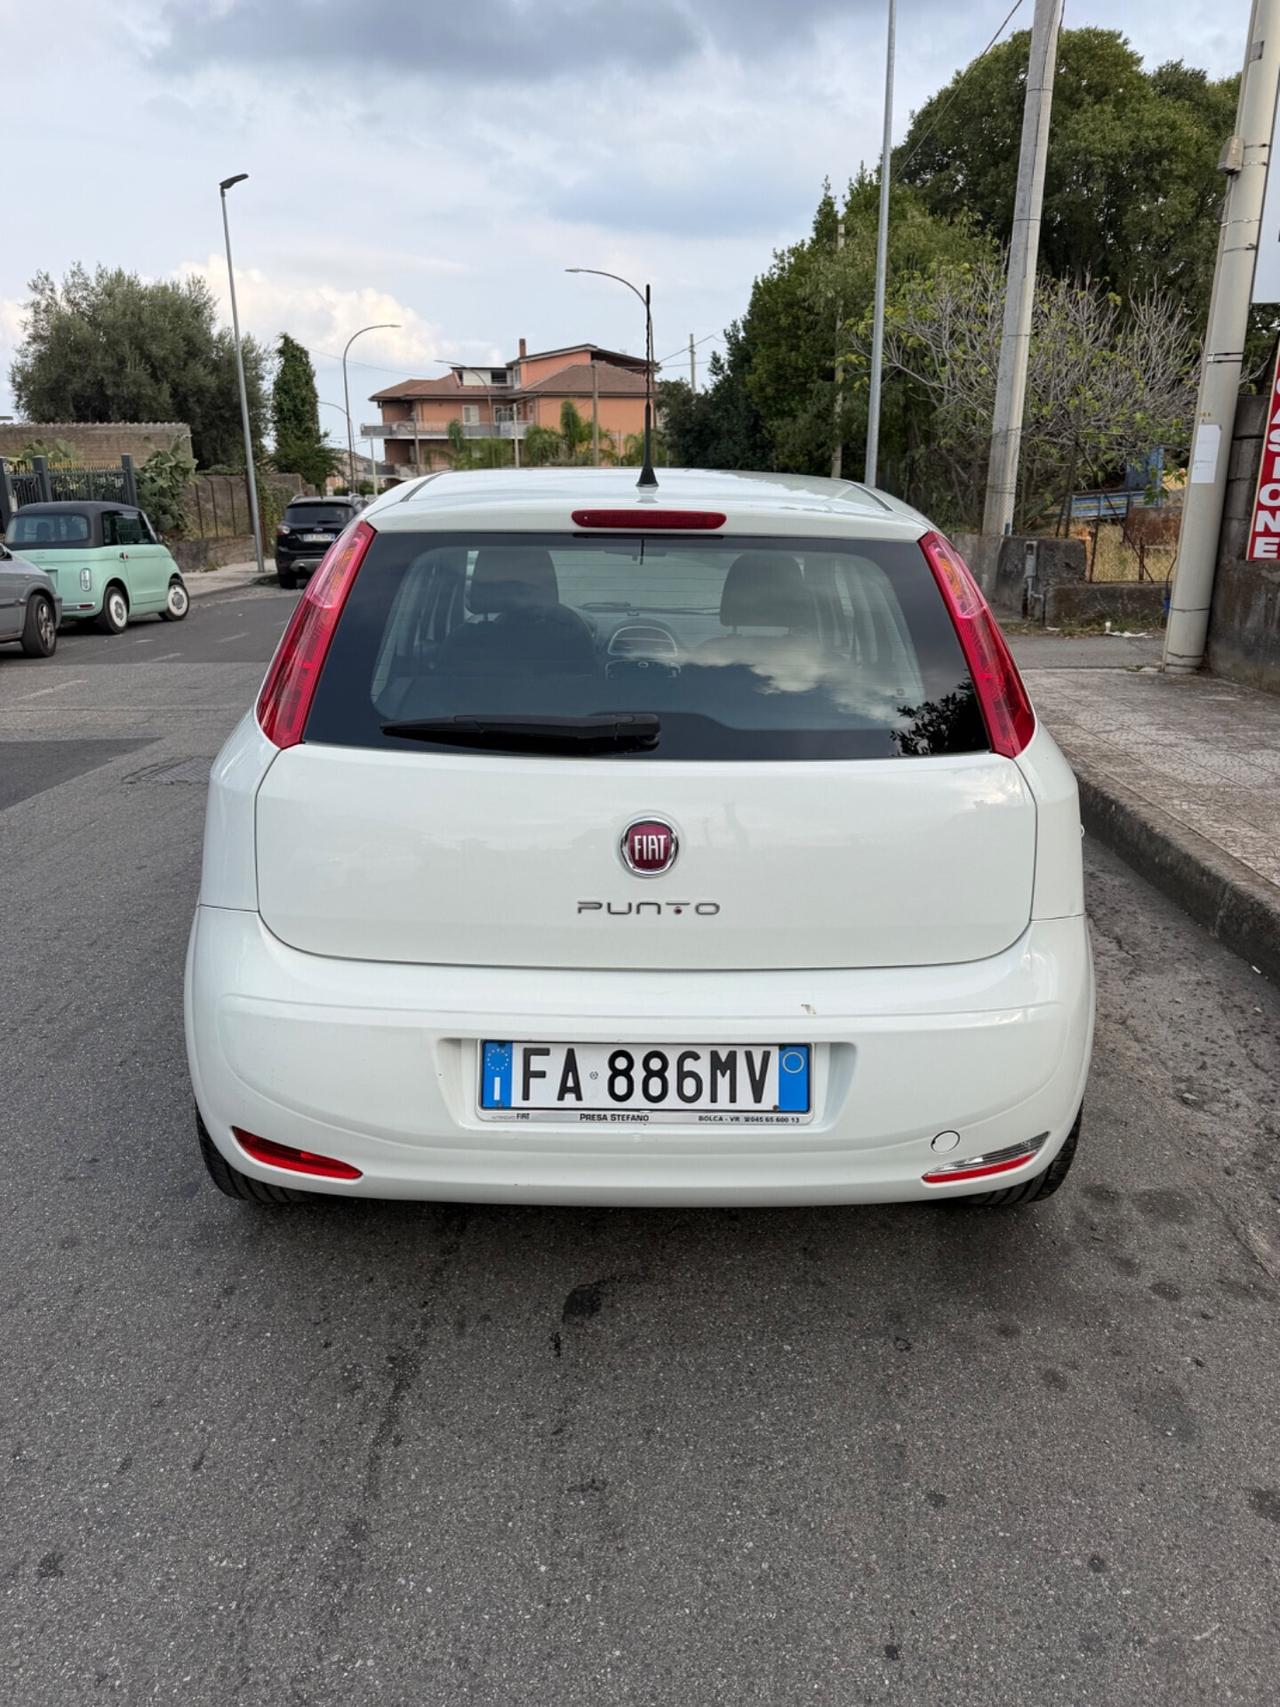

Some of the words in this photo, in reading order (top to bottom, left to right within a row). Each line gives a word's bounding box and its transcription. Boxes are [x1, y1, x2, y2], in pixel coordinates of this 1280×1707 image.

[634, 834, 668, 861] FIAT
[577, 901, 721, 916] PUNTO
[521, 1047, 584, 1102] FA
[607, 1049, 772, 1104] 886MV
[516, 1112, 530, 1120] FIAT
[580, 1113, 608, 1121] PRESA
[610, 1114, 649, 1122] STEFANO
